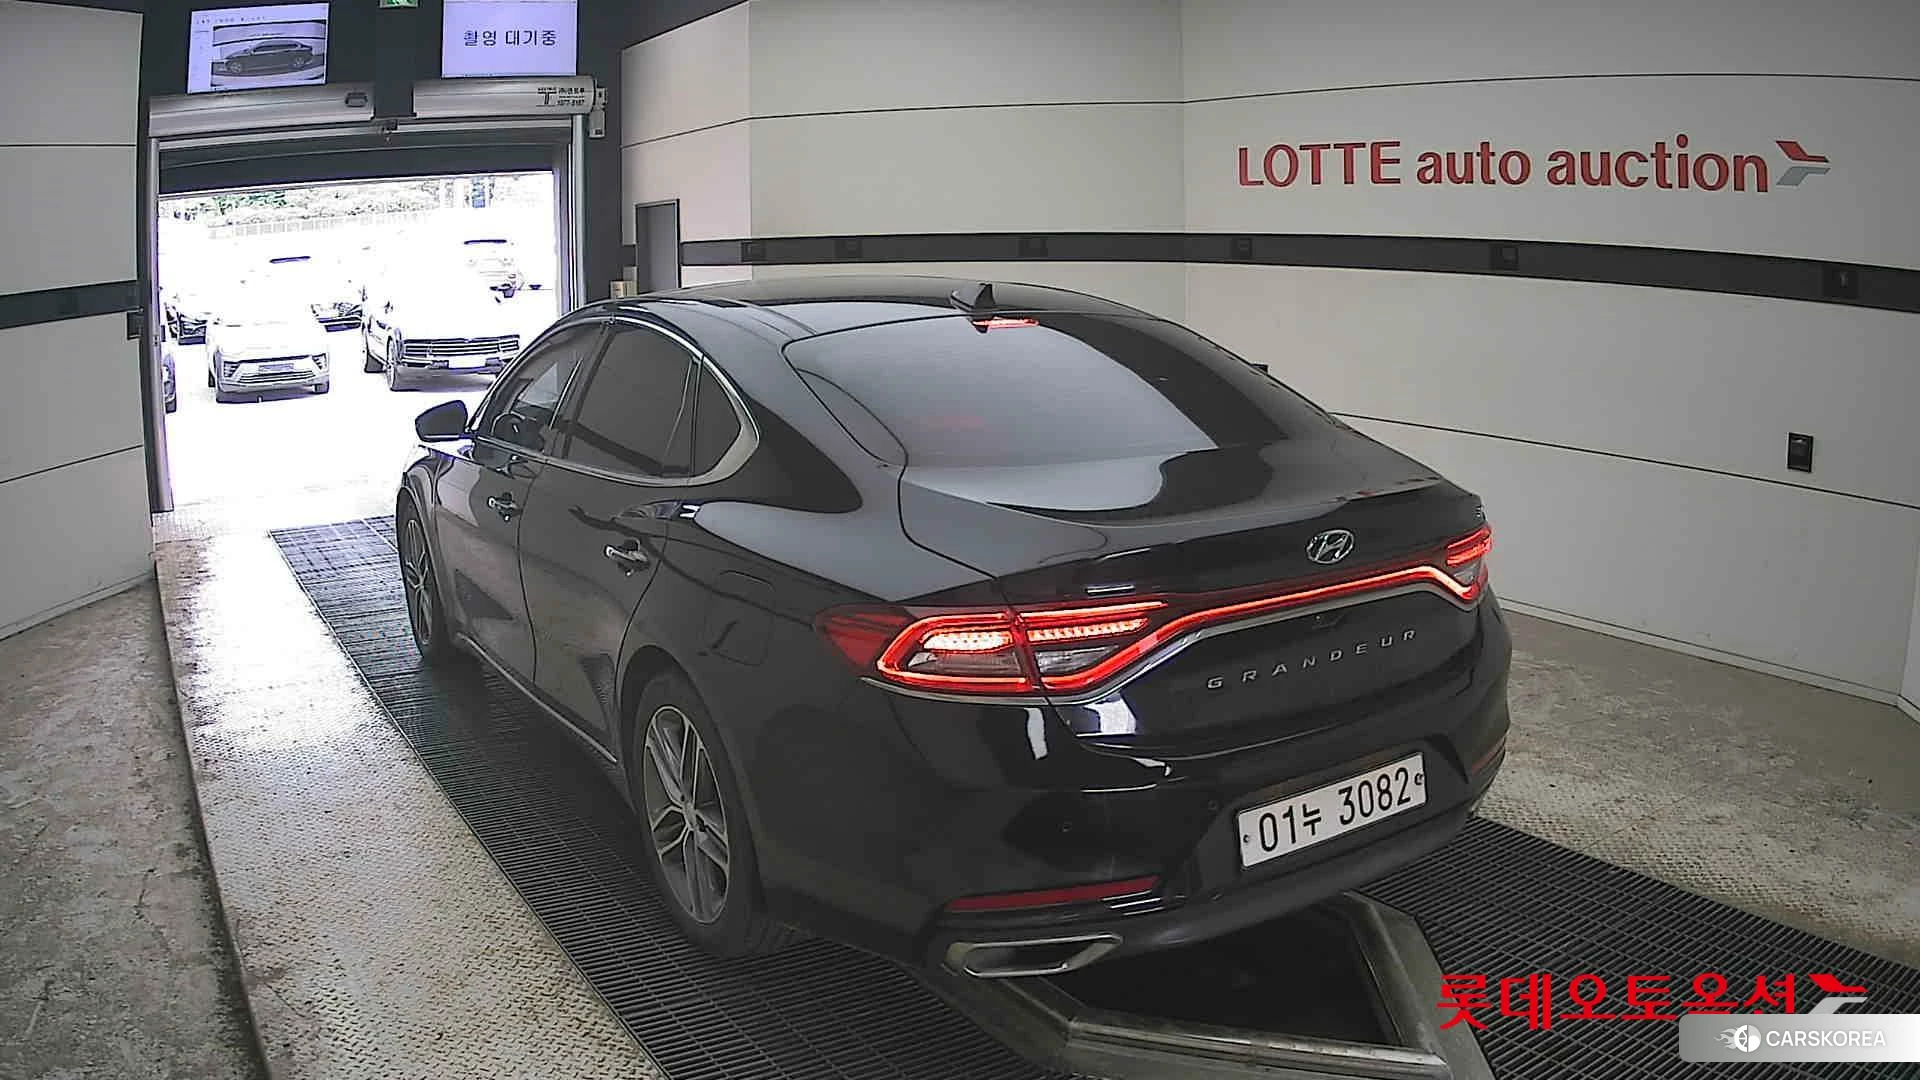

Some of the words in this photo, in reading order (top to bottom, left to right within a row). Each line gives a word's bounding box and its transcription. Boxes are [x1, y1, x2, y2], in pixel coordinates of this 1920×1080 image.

[505, 29, 557, 46] 대기중
[1238, 141, 1401, 188] LOTTE
[1417, 141, 1531, 185] auto
[1547, 133, 1769, 193] auction
[1207, 628, 1416, 690] GRANDEUR
[1259, 803, 1322, 852] 01누
[1338, 767, 1411, 826] 3082
